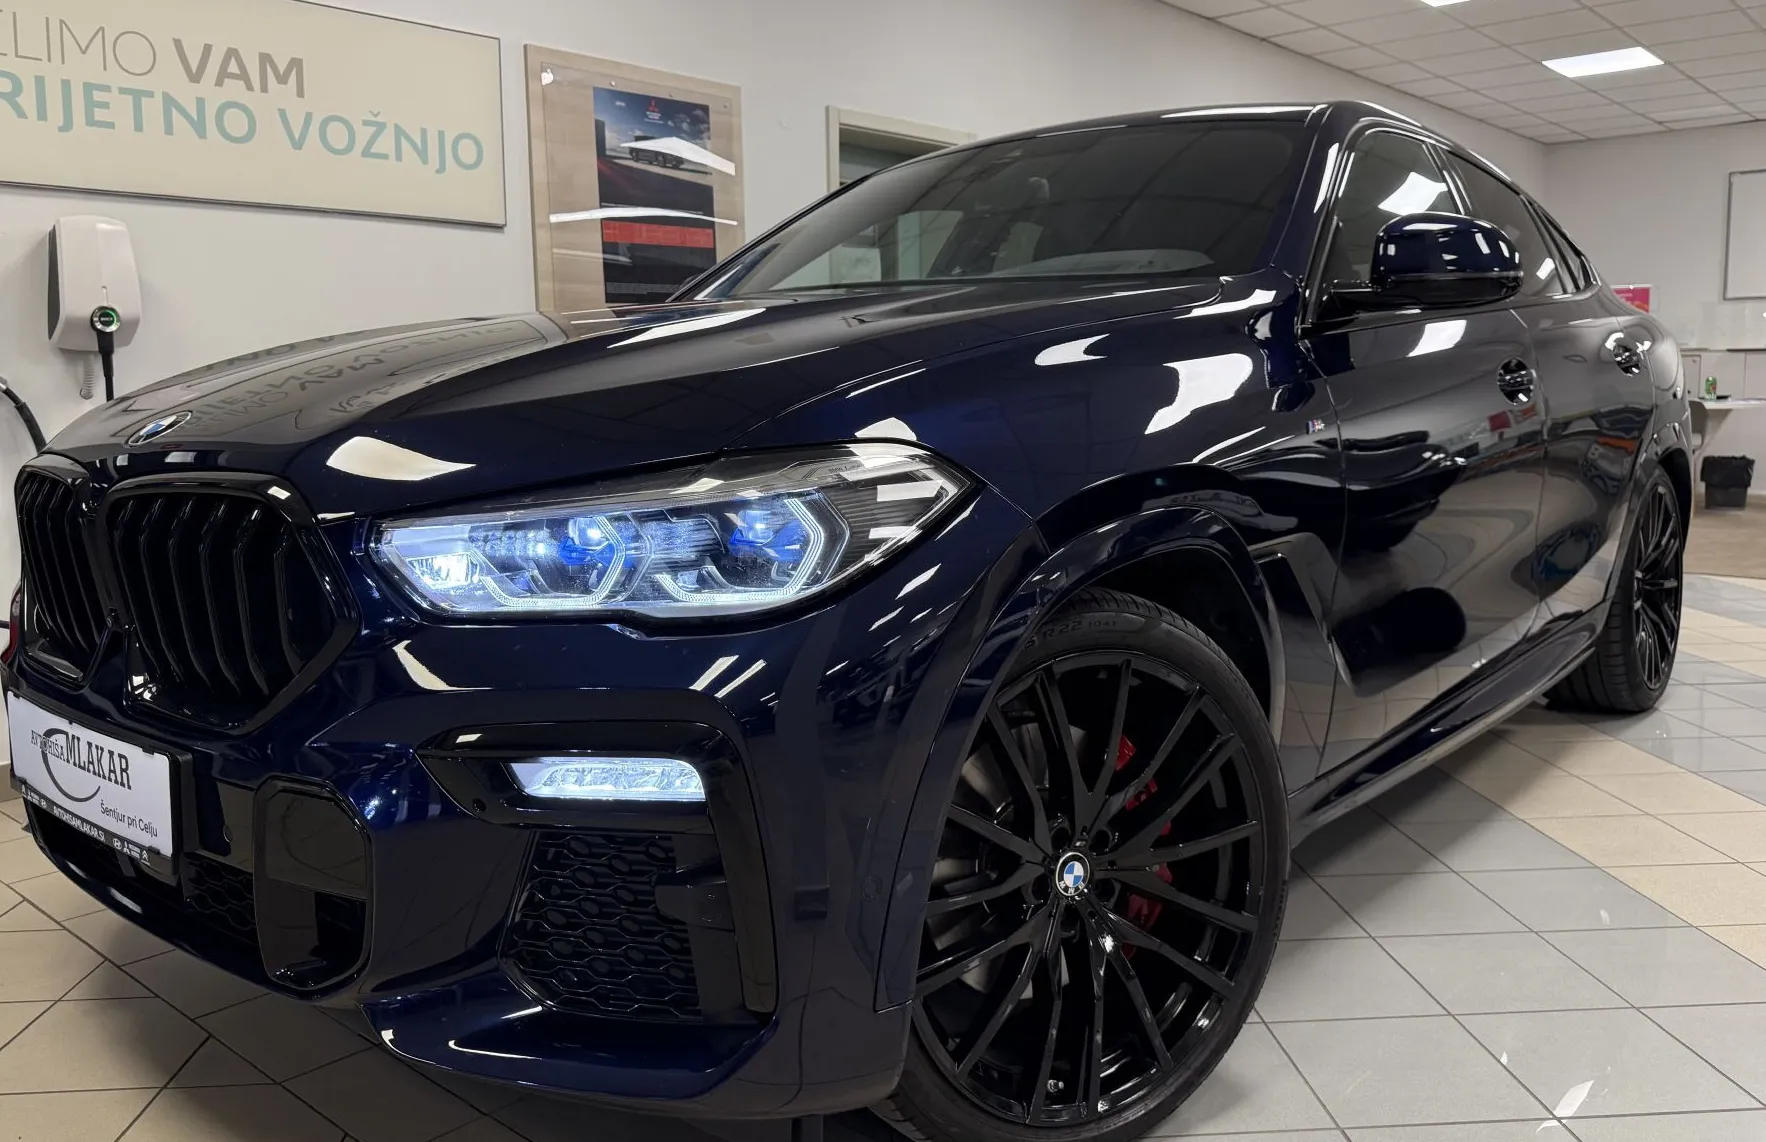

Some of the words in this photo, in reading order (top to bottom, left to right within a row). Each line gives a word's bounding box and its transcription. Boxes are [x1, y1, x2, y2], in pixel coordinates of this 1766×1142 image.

[0, 8, 157, 77] LIMO
[172, 37, 305, 99] VAM
[277, 107, 484, 175] VOŽNJO
[31, 730, 66, 762] AVTOHIŠA
[66, 733, 132, 790] MLAKAR
[100, 799, 126, 824] Šentjur
[127, 815, 138, 829] pri
[138, 819, 158, 838] Celju
